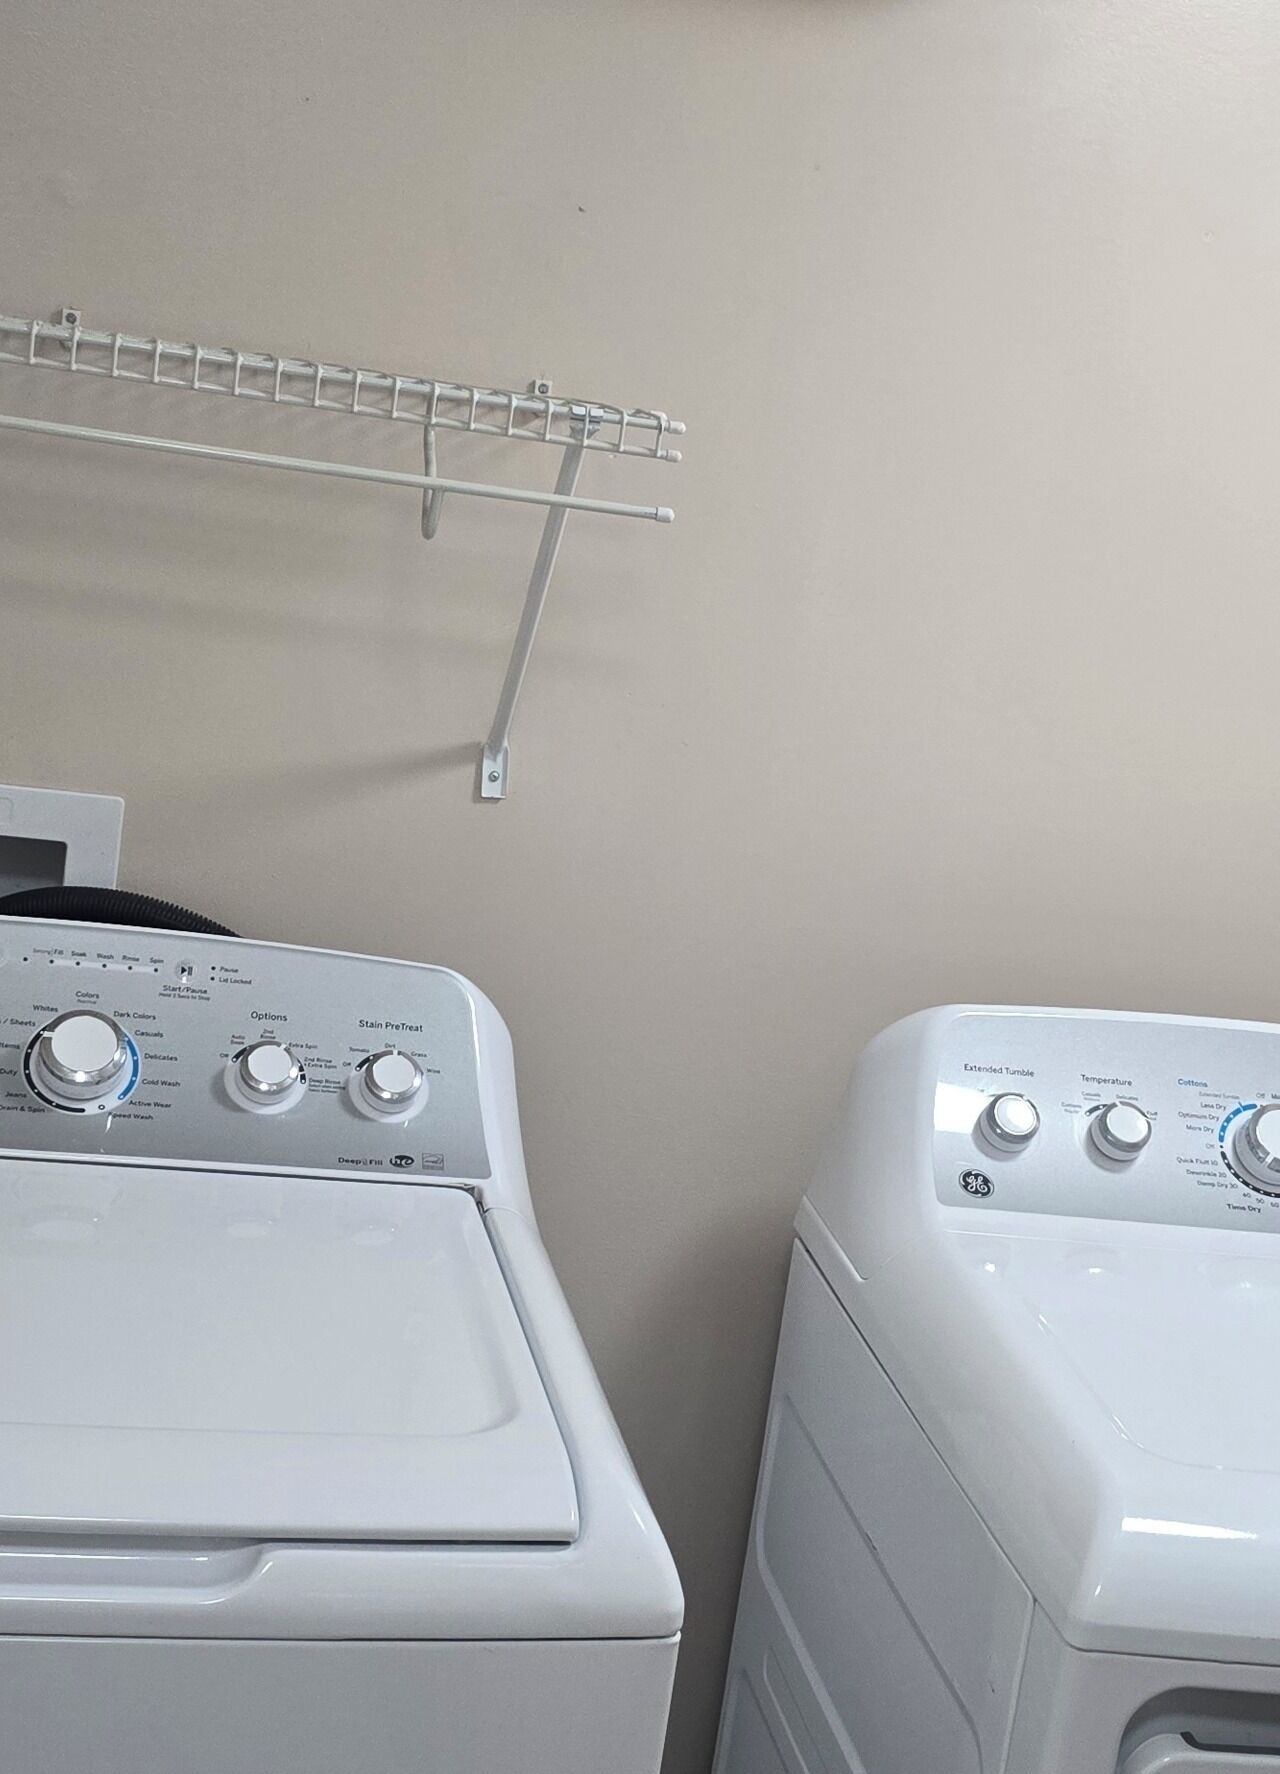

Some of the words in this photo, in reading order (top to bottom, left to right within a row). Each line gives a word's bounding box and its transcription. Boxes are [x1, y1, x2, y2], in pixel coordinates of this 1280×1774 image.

[162, 984, 208, 995] Start/Pause
[75, 990, 100, 1000] Colors
[32, 1004, 59, 1013] Whites
[114, 1010, 131, 1018] Dark
[132, 1012, 157, 1020] Colors
[250, 1010, 288, 1022] Options
[10, 1018, 36, 1028] Sheets
[358, 1019, 383, 1030] Stain
[384, 1020, 424, 1032] PreTreat
[134, 1029, 164, 1038] Casuals
[144, 1052, 178, 1062] Delicates
[0, 1068, 19, 1077] Duty
[964, 1063, 1003, 1075] Extended
[1004, 1066, 1035, 1078] Tumble
[142, 1078, 159, 1086] Cold
[160, 1079, 181, 1088] Wash
[1080, 1074, 1133, 1087] Temperature
[1176, 1078, 1209, 1088] Cottons
[4, 1091, 28, 1099] Jeans
[128, 1100, 152, 1108] Active
[1214, 1103, 1227, 1112] Dry
[27, 1106, 46, 1114] Spin
[133, 1112, 154, 1121] Wash
[1186, 1124, 1202, 1132] More
[1202, 1126, 1215, 1134] Dry
[338, 1156, 362, 1166] Deep
[1176, 1156, 1194, 1164] Quick
[1226, 1202, 1246, 1212] Time
[1247, 1204, 1262, 1214] Dry
